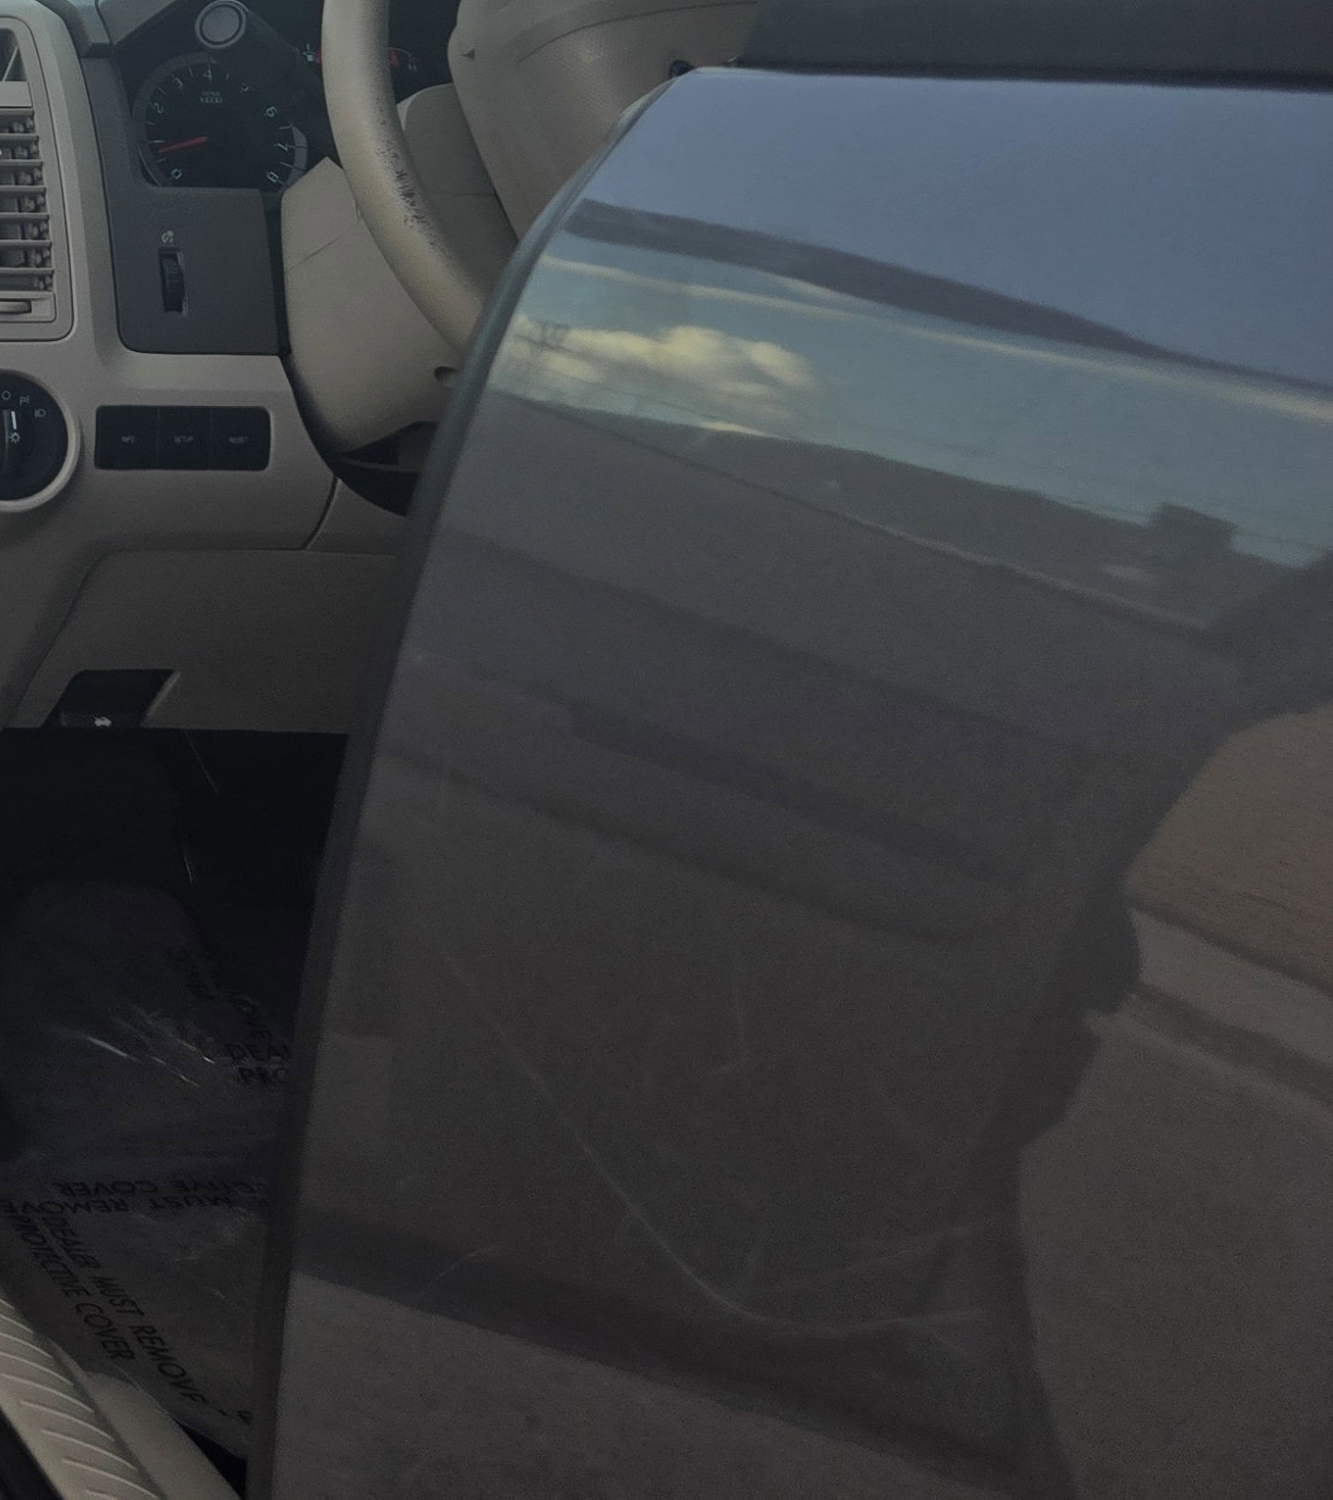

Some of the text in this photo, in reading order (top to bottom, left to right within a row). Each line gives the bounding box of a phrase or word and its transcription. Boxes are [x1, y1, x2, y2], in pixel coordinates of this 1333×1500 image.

[53, 1179, 158, 1197] COVER
[11, 1211, 137, 1361] PROTECTIVE COVER
[41, 1215, 209, 1405] DEALER MUST REMOVE
